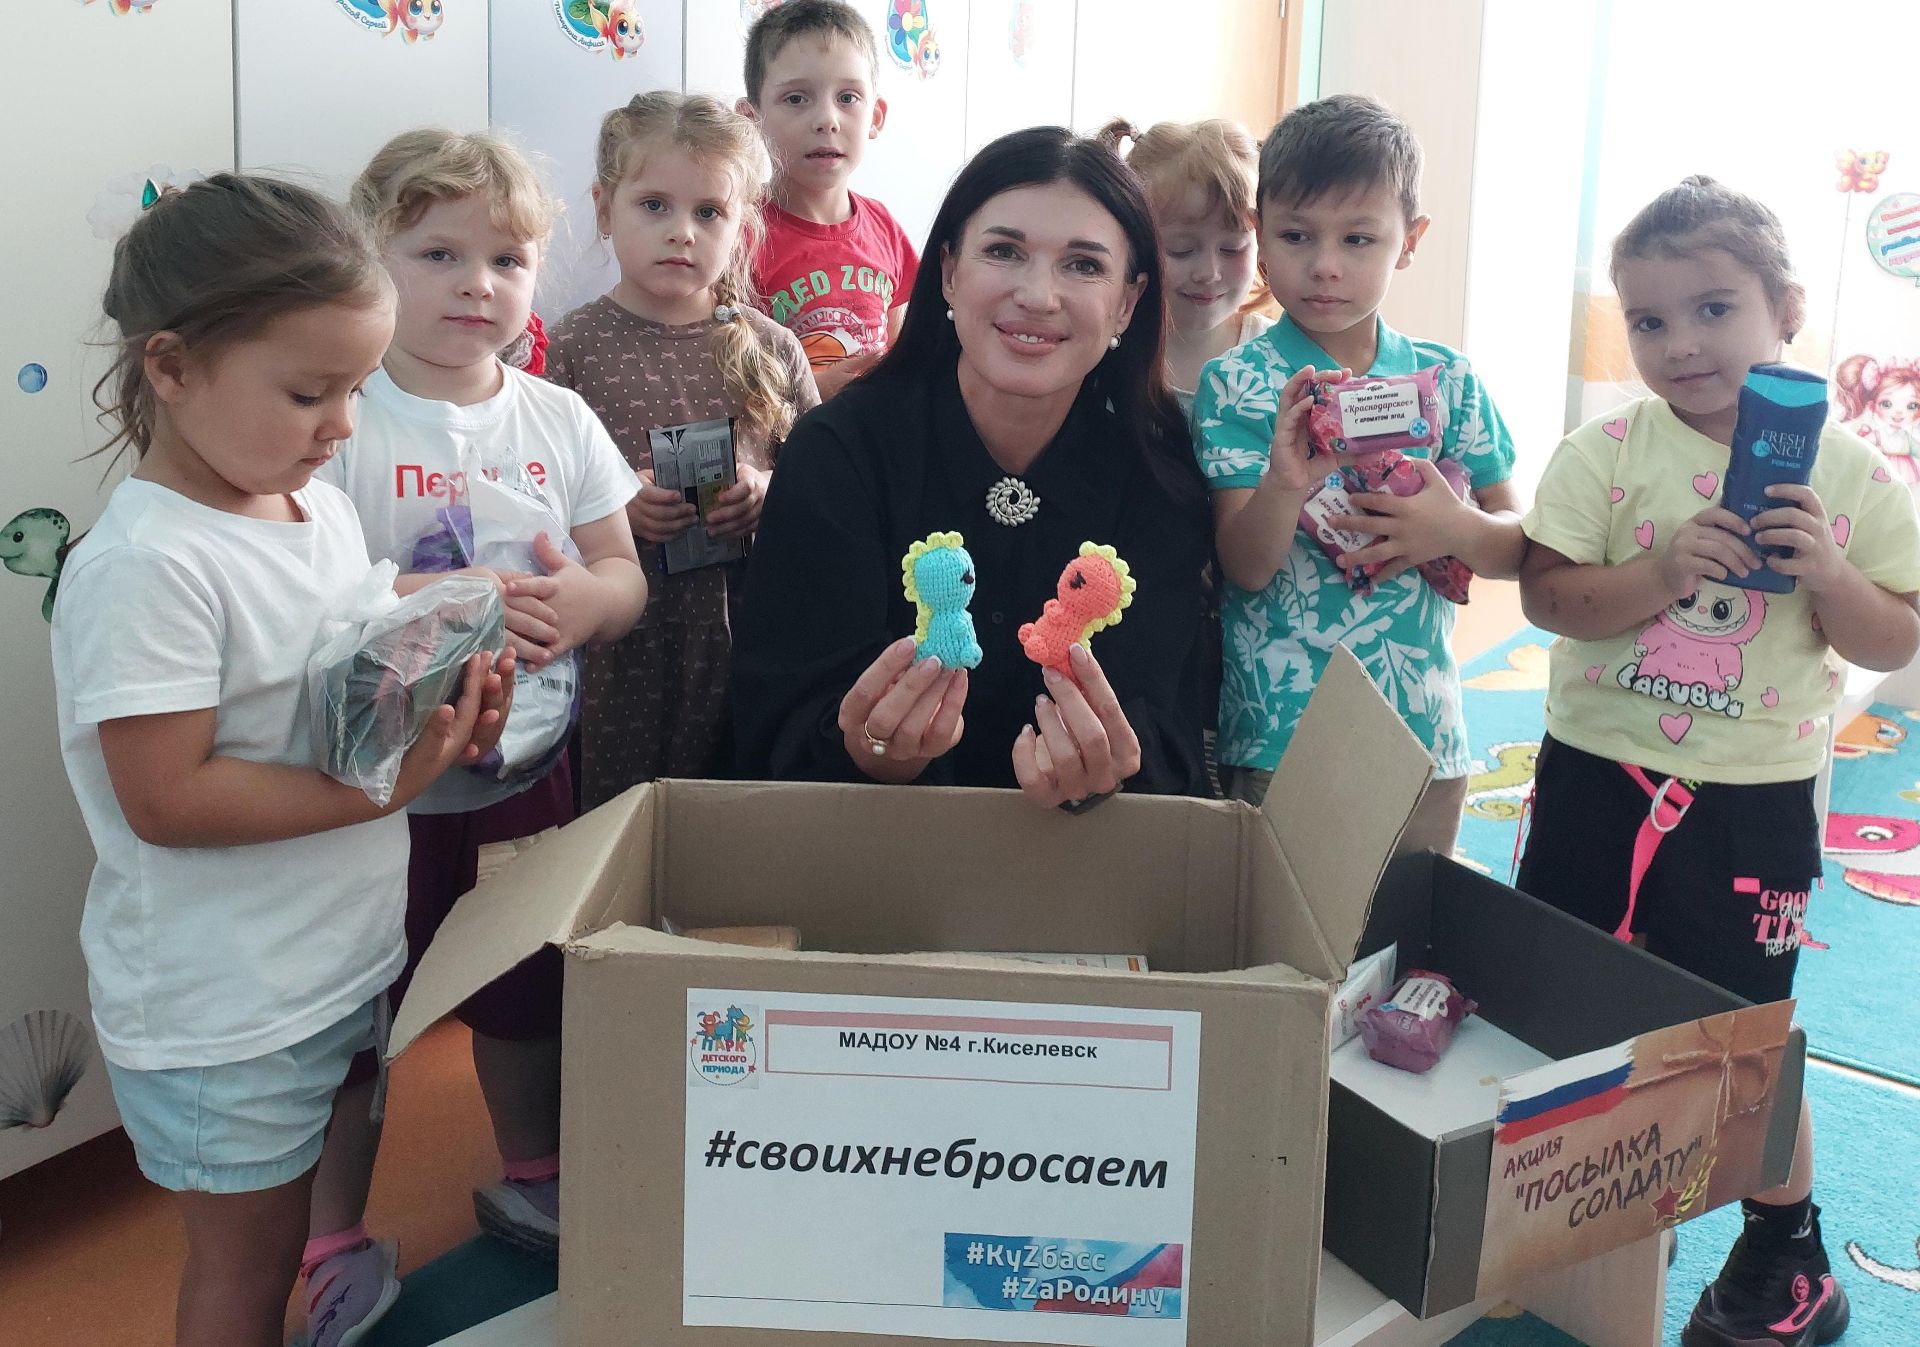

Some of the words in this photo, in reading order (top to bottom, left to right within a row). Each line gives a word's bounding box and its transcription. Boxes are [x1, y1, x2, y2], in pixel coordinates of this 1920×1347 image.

[770, 270, 831, 326] RED
[840, 265, 894, 309] ZON
[1760, 429, 1806, 449] FRESH
[1769, 442, 1804, 458] NICE
[1760, 889, 1810, 912] GOO
[701, 1038, 746, 1052] ПАРК
[701, 1054, 747, 1063] ДЕТСКОГО
[839, 1031, 918, 1052] МАДОУ
[925, 1035, 961, 1051] №4
[968, 1037, 1098, 1059] г.Киселевск
[702, 1065, 745, 1075] ПЕРИОДА
[704, 1130, 1169, 1188] #своихнебросаем
[1503, 1135, 1564, 1179] АКЦИЯ
[1515, 1122, 1662, 1212] "ПОСЫЛКА
[1568, 1135, 1703, 1228] СОЛДАТУ"
[966, 1241, 1106, 1273] #КуZбасс
[1001, 1276, 1165, 1313] #ZаРодину
